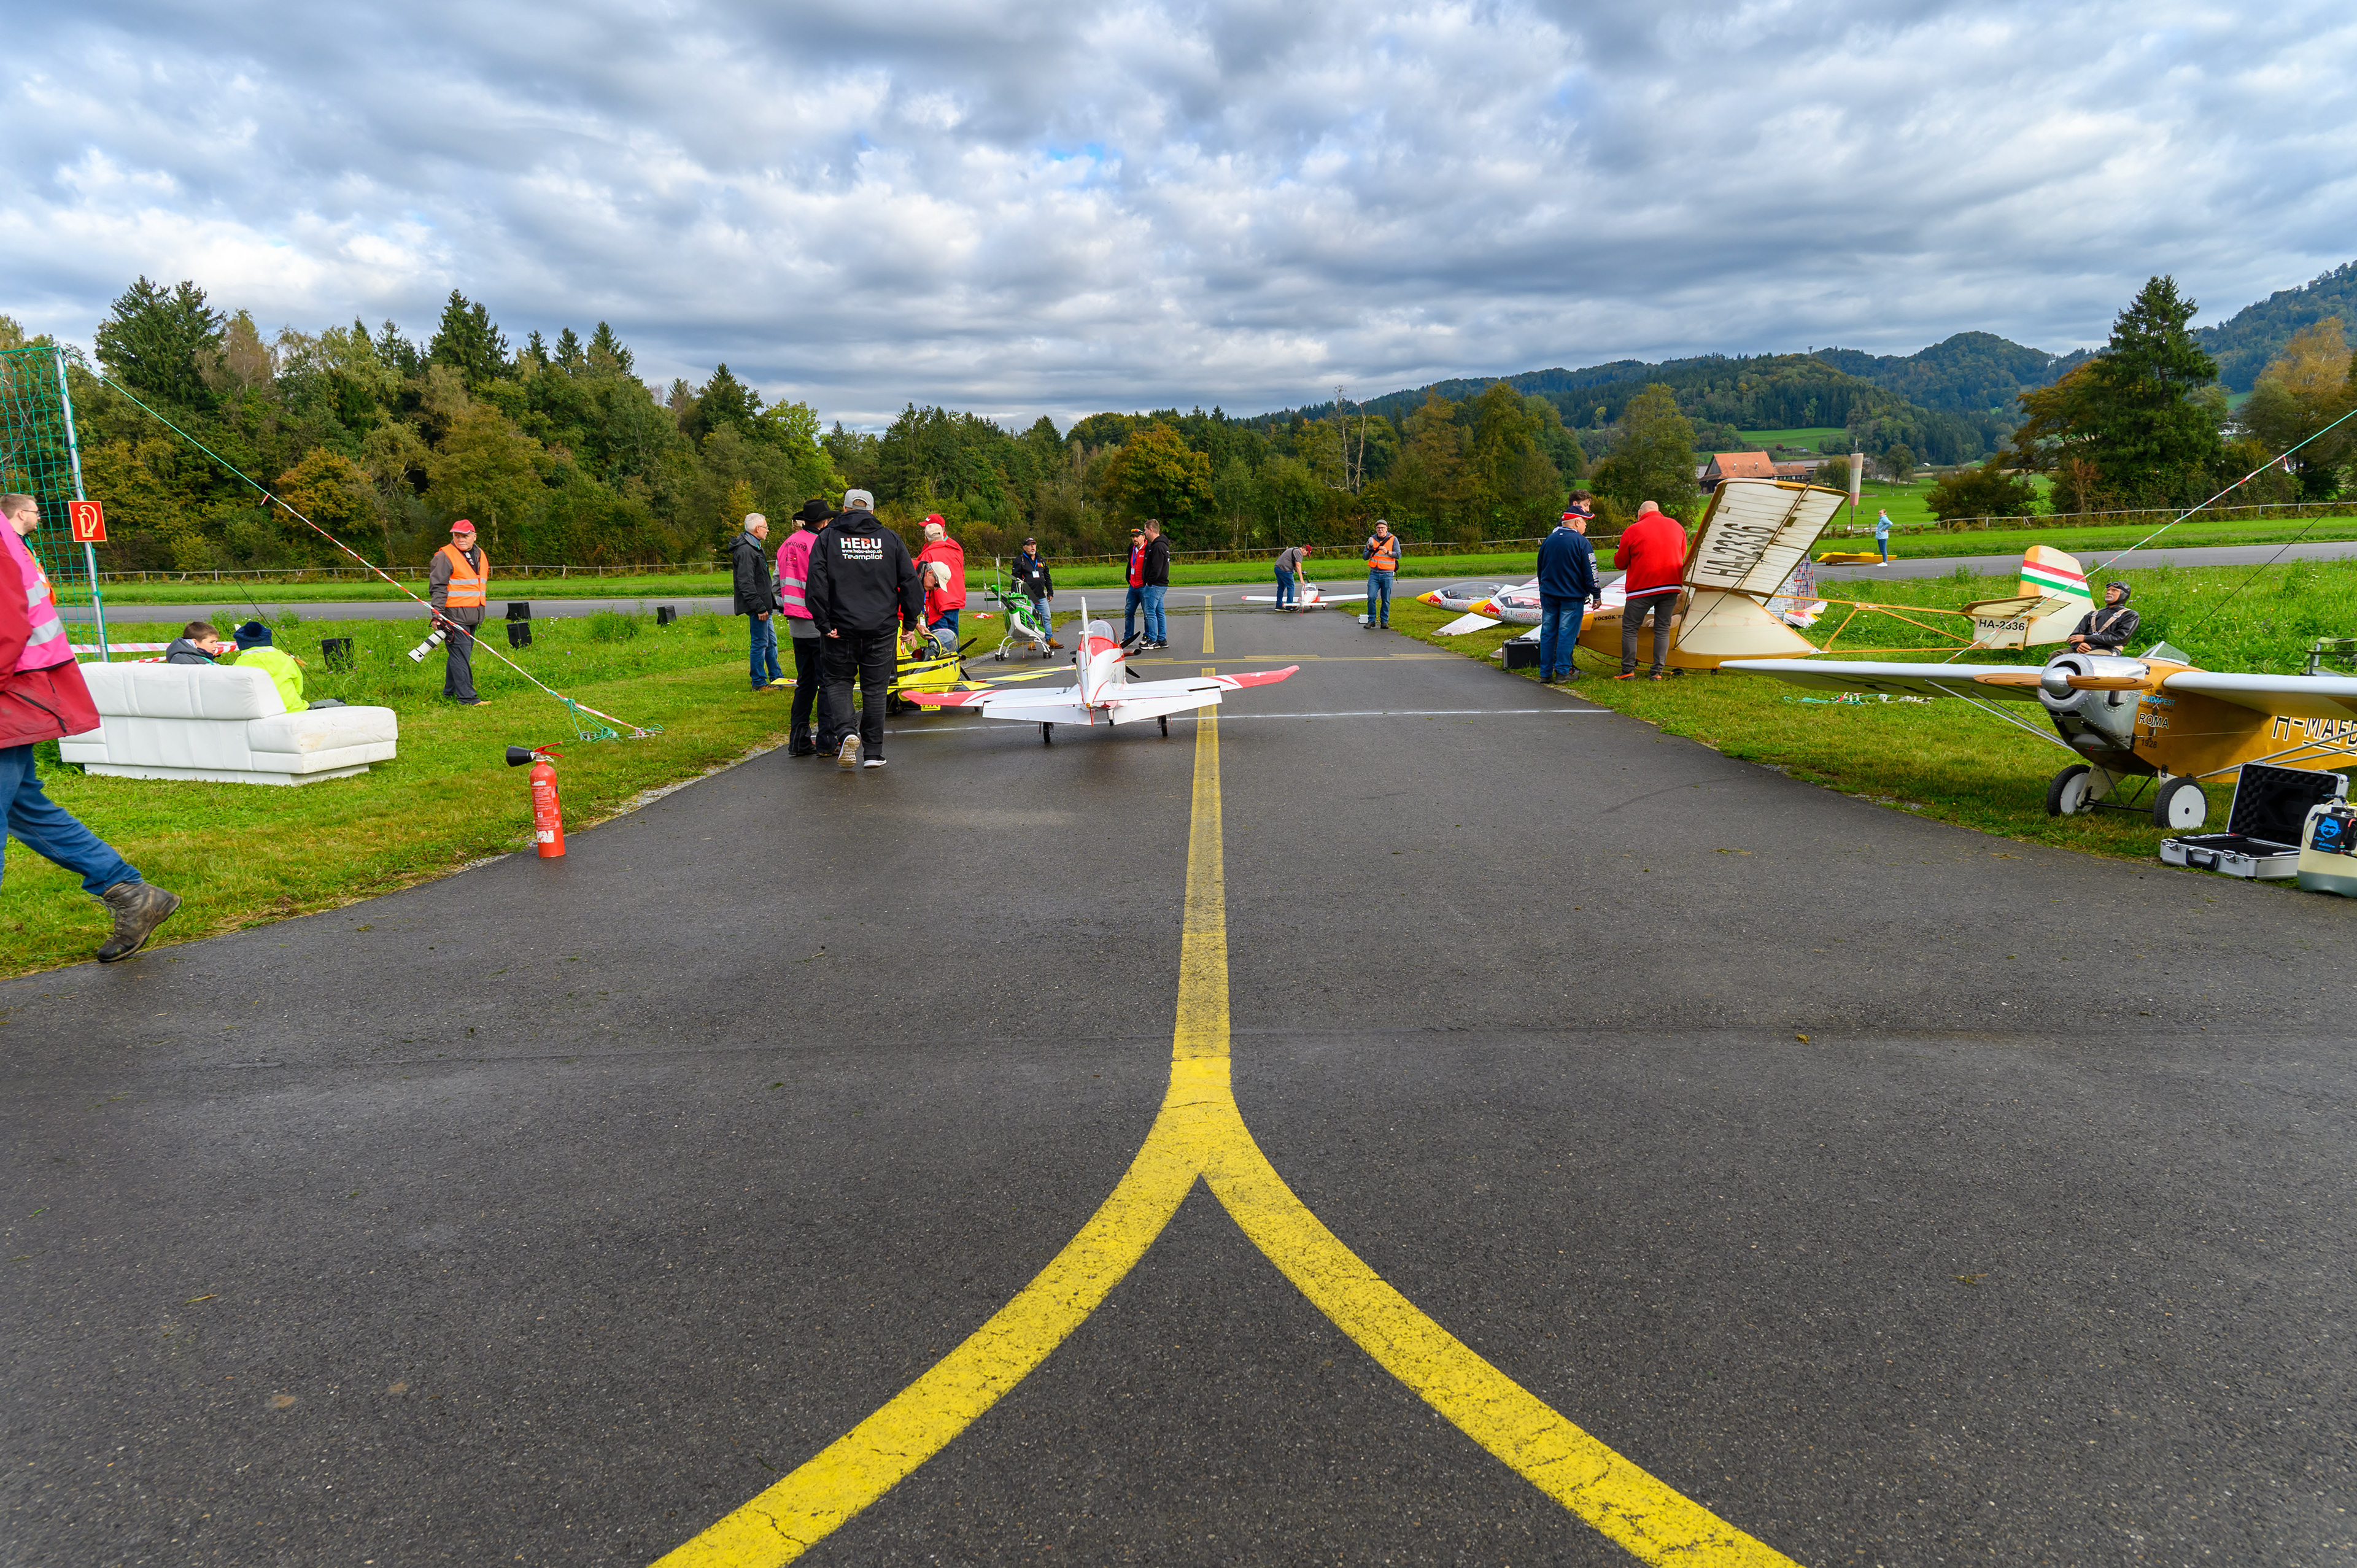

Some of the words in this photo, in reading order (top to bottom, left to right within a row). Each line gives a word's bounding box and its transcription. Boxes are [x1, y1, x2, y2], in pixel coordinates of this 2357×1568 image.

[840, 538, 881, 549] HEBU
[1701, 523, 1776, 579] HA-2336
[1979, 619, 2025, 631] HA-2336
[2141, 695, 2175, 706] BUDAPEST
[2138, 713, 2169, 729] ROMA
[2141, 739, 2157, 748] 1928
